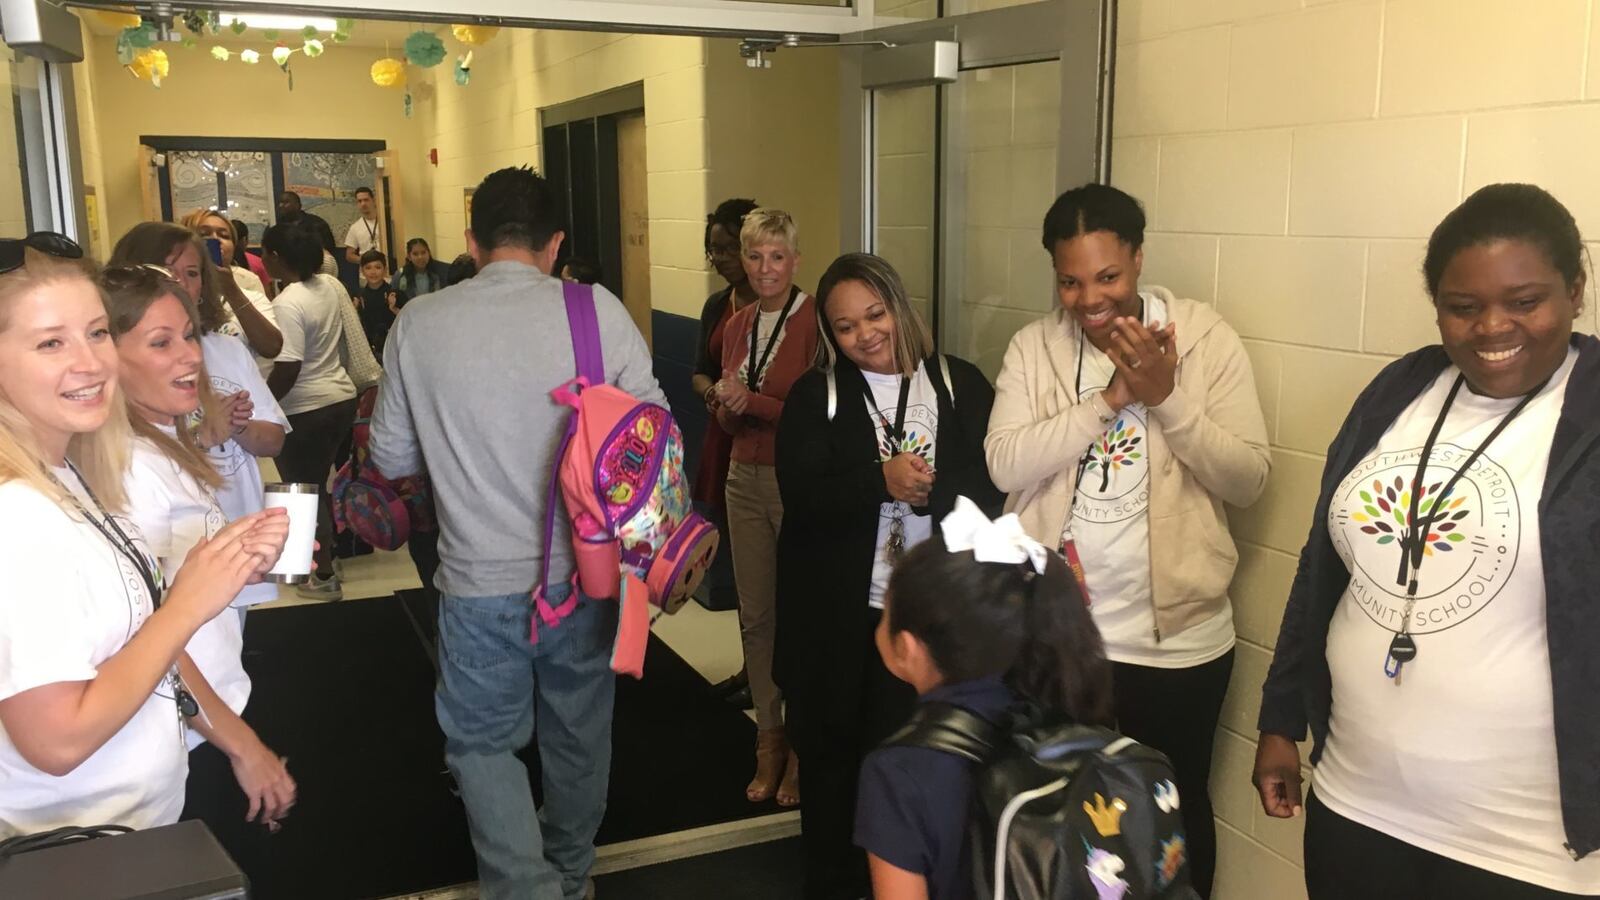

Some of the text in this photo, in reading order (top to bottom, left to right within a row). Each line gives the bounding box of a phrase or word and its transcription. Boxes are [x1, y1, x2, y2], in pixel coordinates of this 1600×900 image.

[1114, 491, 1149, 516] SCHO
[1351, 574, 1495, 627] MUNITY SCHOOL
